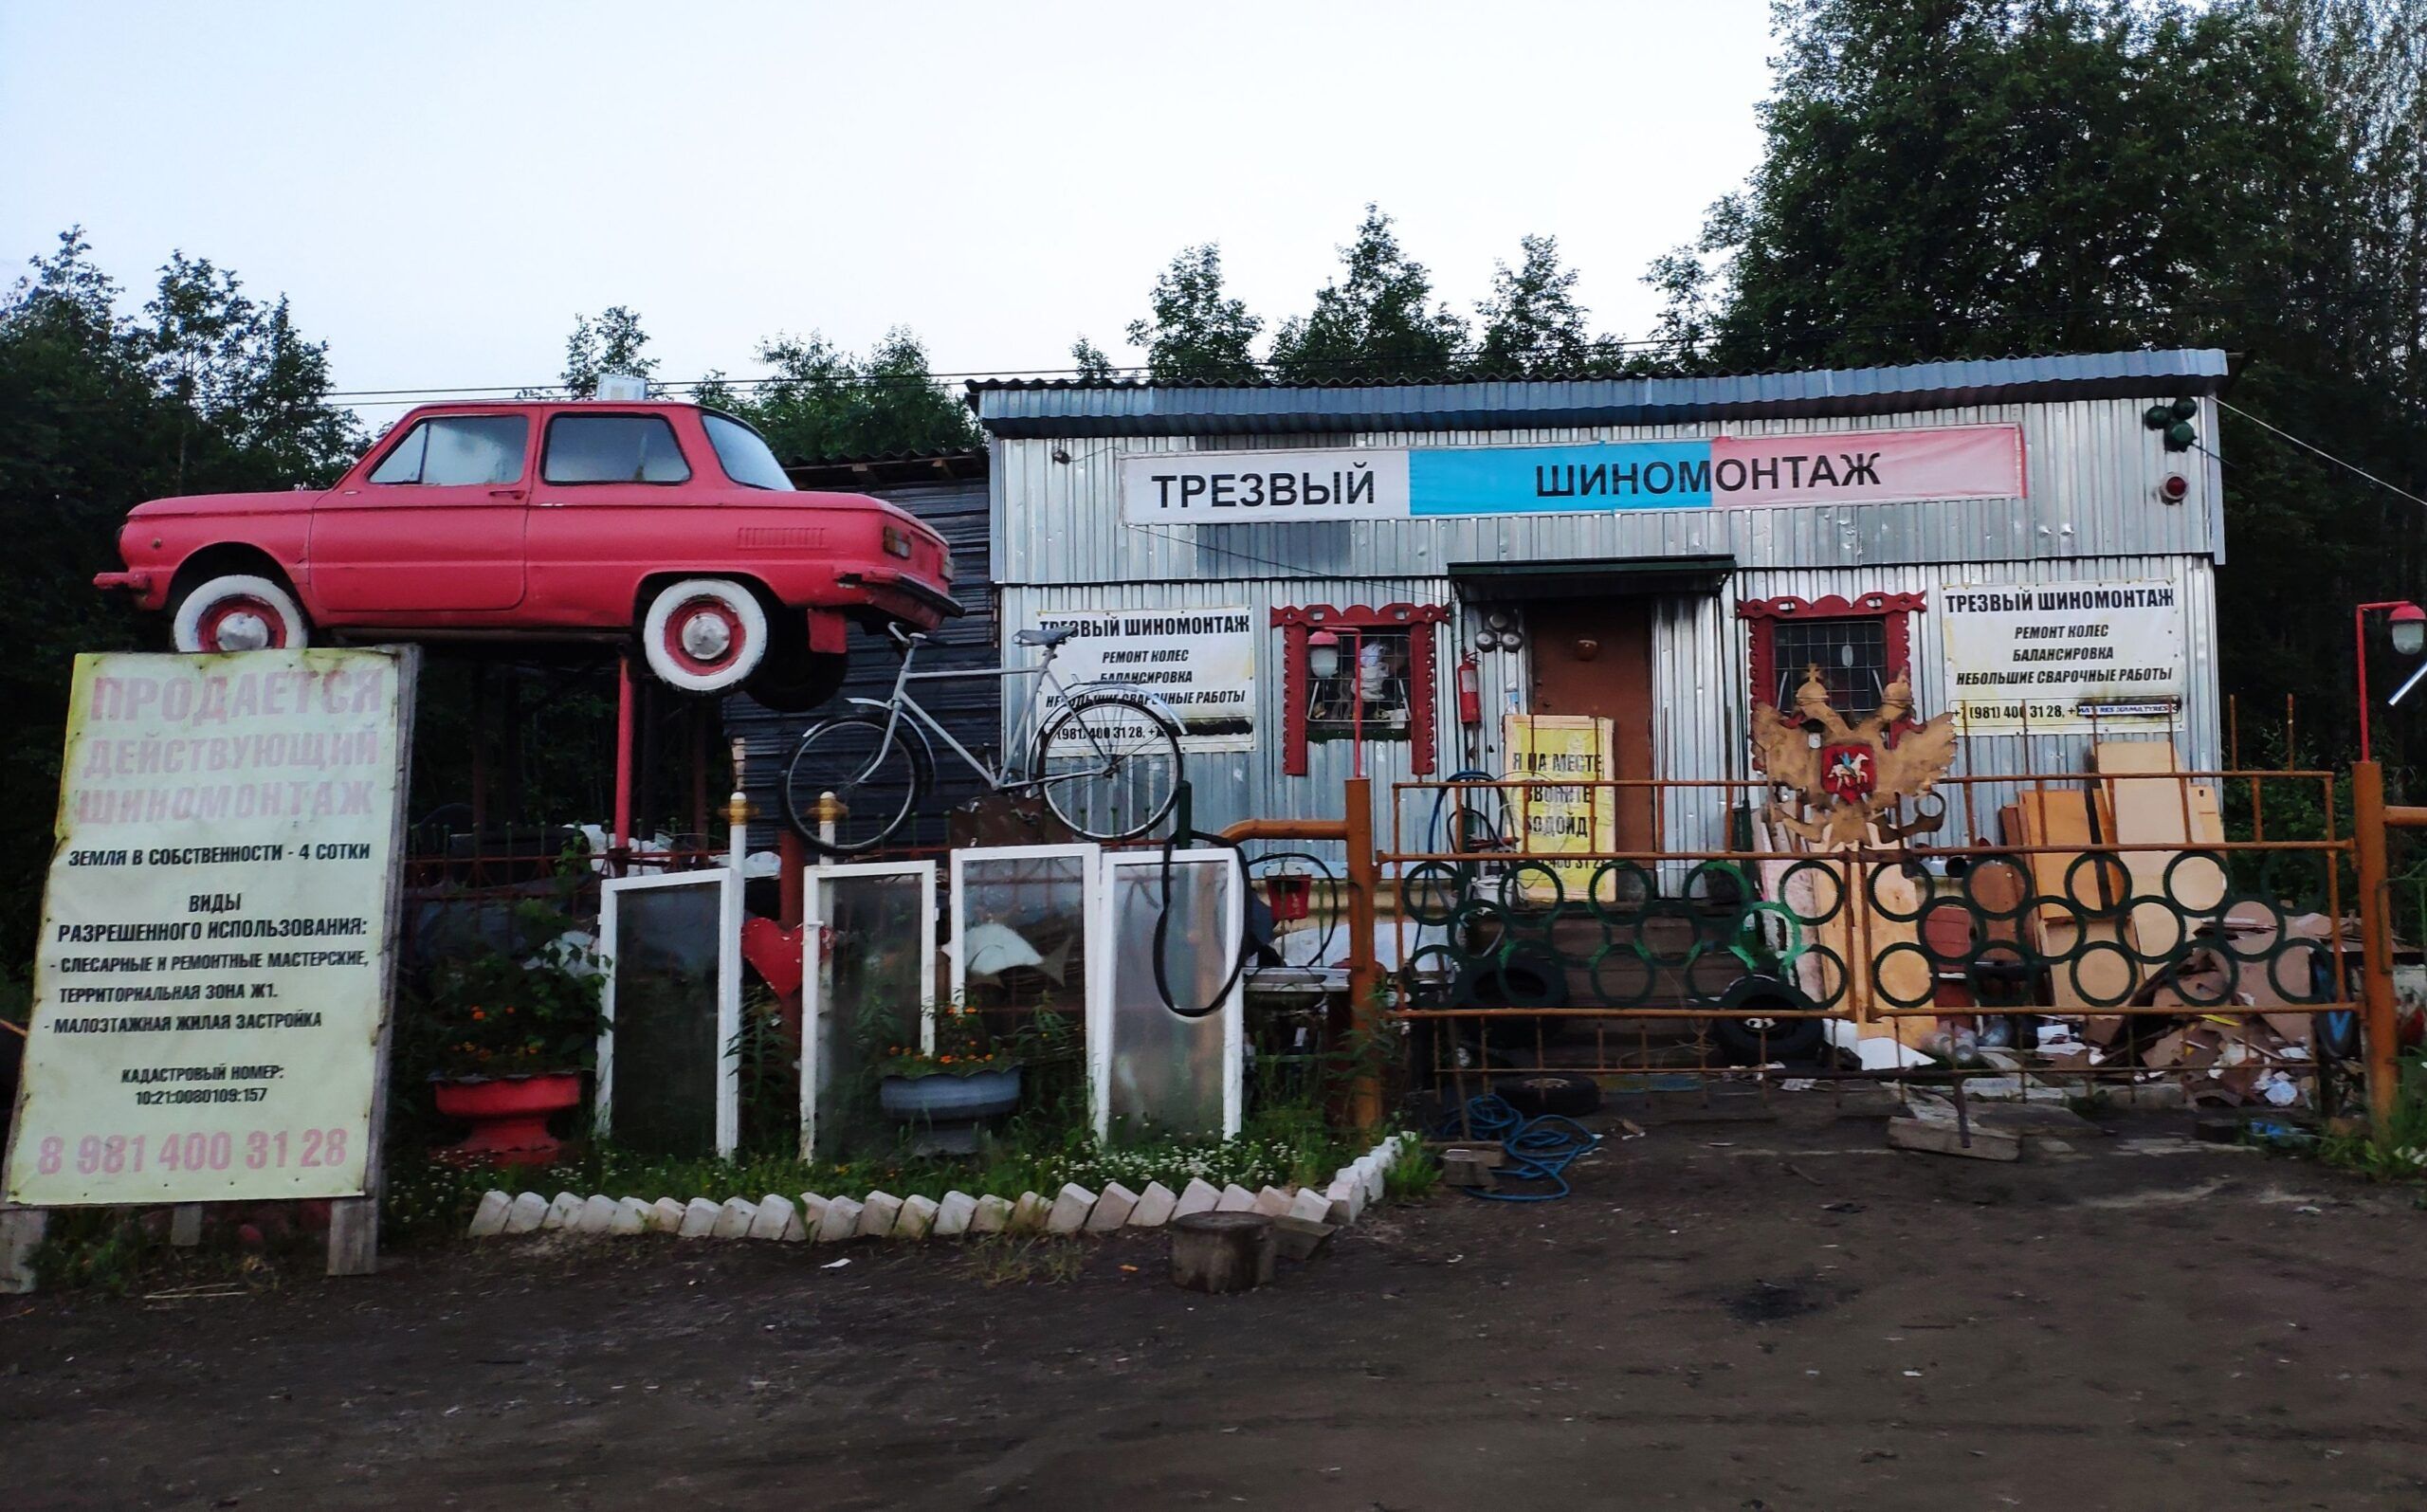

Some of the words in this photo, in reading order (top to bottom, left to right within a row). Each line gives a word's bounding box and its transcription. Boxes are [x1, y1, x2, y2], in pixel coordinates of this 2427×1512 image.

[1150, 461, 1375, 508] ТРЕЗВЫЙ
[1536, 452, 1881, 498] ШИНОМОНТАЖ
[1944, 590, 2034, 613] ТРЕЗВЫЙ
[2038, 588, 2174, 610] ШИНОМОНТАЖ
[1124, 615, 1250, 637] ШИНОМОНТАЖ
[2015, 626, 2066, 640] РЕМОНТ
[2068, 625, 2109, 638] КОЛЕС
[1102, 650, 1150, 664] РЕМОНТ
[1151, 649, 1189, 663] КОЛЕС
[2013, 647, 2114, 663] БАЛАНСИРОВКА
[1956, 671, 2034, 685] НЕБОЛЬШИЕ
[2037, 669, 2116, 683] СВАРОЧНЫЕ
[2119, 667, 2173, 682] РАБОТЫ
[90, 668, 384, 727] ПРОДАЕТСЯ
[1045, 693, 1120, 708] НЕОЛЬ
[1195, 690, 1246, 704] РАБОТЫ
[2030, 705, 2044, 718] 31
[1113, 726, 1126, 738] 31
[82, 722, 378, 779] ДЕЙСТВУЮЩИЙ
[1512, 752, 1523, 771] Я
[78, 780, 375, 825] ШИНОМОНТАЖ
[68, 849, 128, 866] ЗЕМЛЯ
[132, 849, 143, 865] В
[148, 844, 283, 865] СОБСТВЕННОСТИ
[299, 844, 310, 860] 4
[316, 843, 371, 860] СОТКИ
[188, 893, 242, 914] ВИДЫ
[57, 921, 202, 942] РАЗРЕШЕННОГО
[208, 918, 368, 938] ИСПОЛЬЗОВАНИЯ:
[61, 956, 154, 973] СЛЕСАРНЫЕ
[156, 956, 168, 972] И
[171, 953, 263, 971] РЕМОНТНЫЕ
[267, 950, 369, 968] МАСТЕРСКИЕ,
[59, 985, 202, 1004] ТЕРРИТОРИАЛЬНАЯ
[205, 983, 246, 999] ЗОНА
[250, 983, 279, 998] Ж1.
[53, 1016, 172, 1034] МАЛОЭТАЖНАЯ
[175, 1014, 231, 1031] ЖИЛАЯ
[236, 1009, 322, 1029] ЗАСТРОЙКА
[120, 1063, 228, 1084] КАДАСТРОВЫЙ
[230, 1065, 284, 1081] НОМЕР:
[37, 1135, 64, 1175] 8
[77, 1134, 147, 1175] 981
[157, 1131, 232, 1172] 400
[245, 1129, 288, 1170] 31
[299, 1127, 349, 1168] 28
